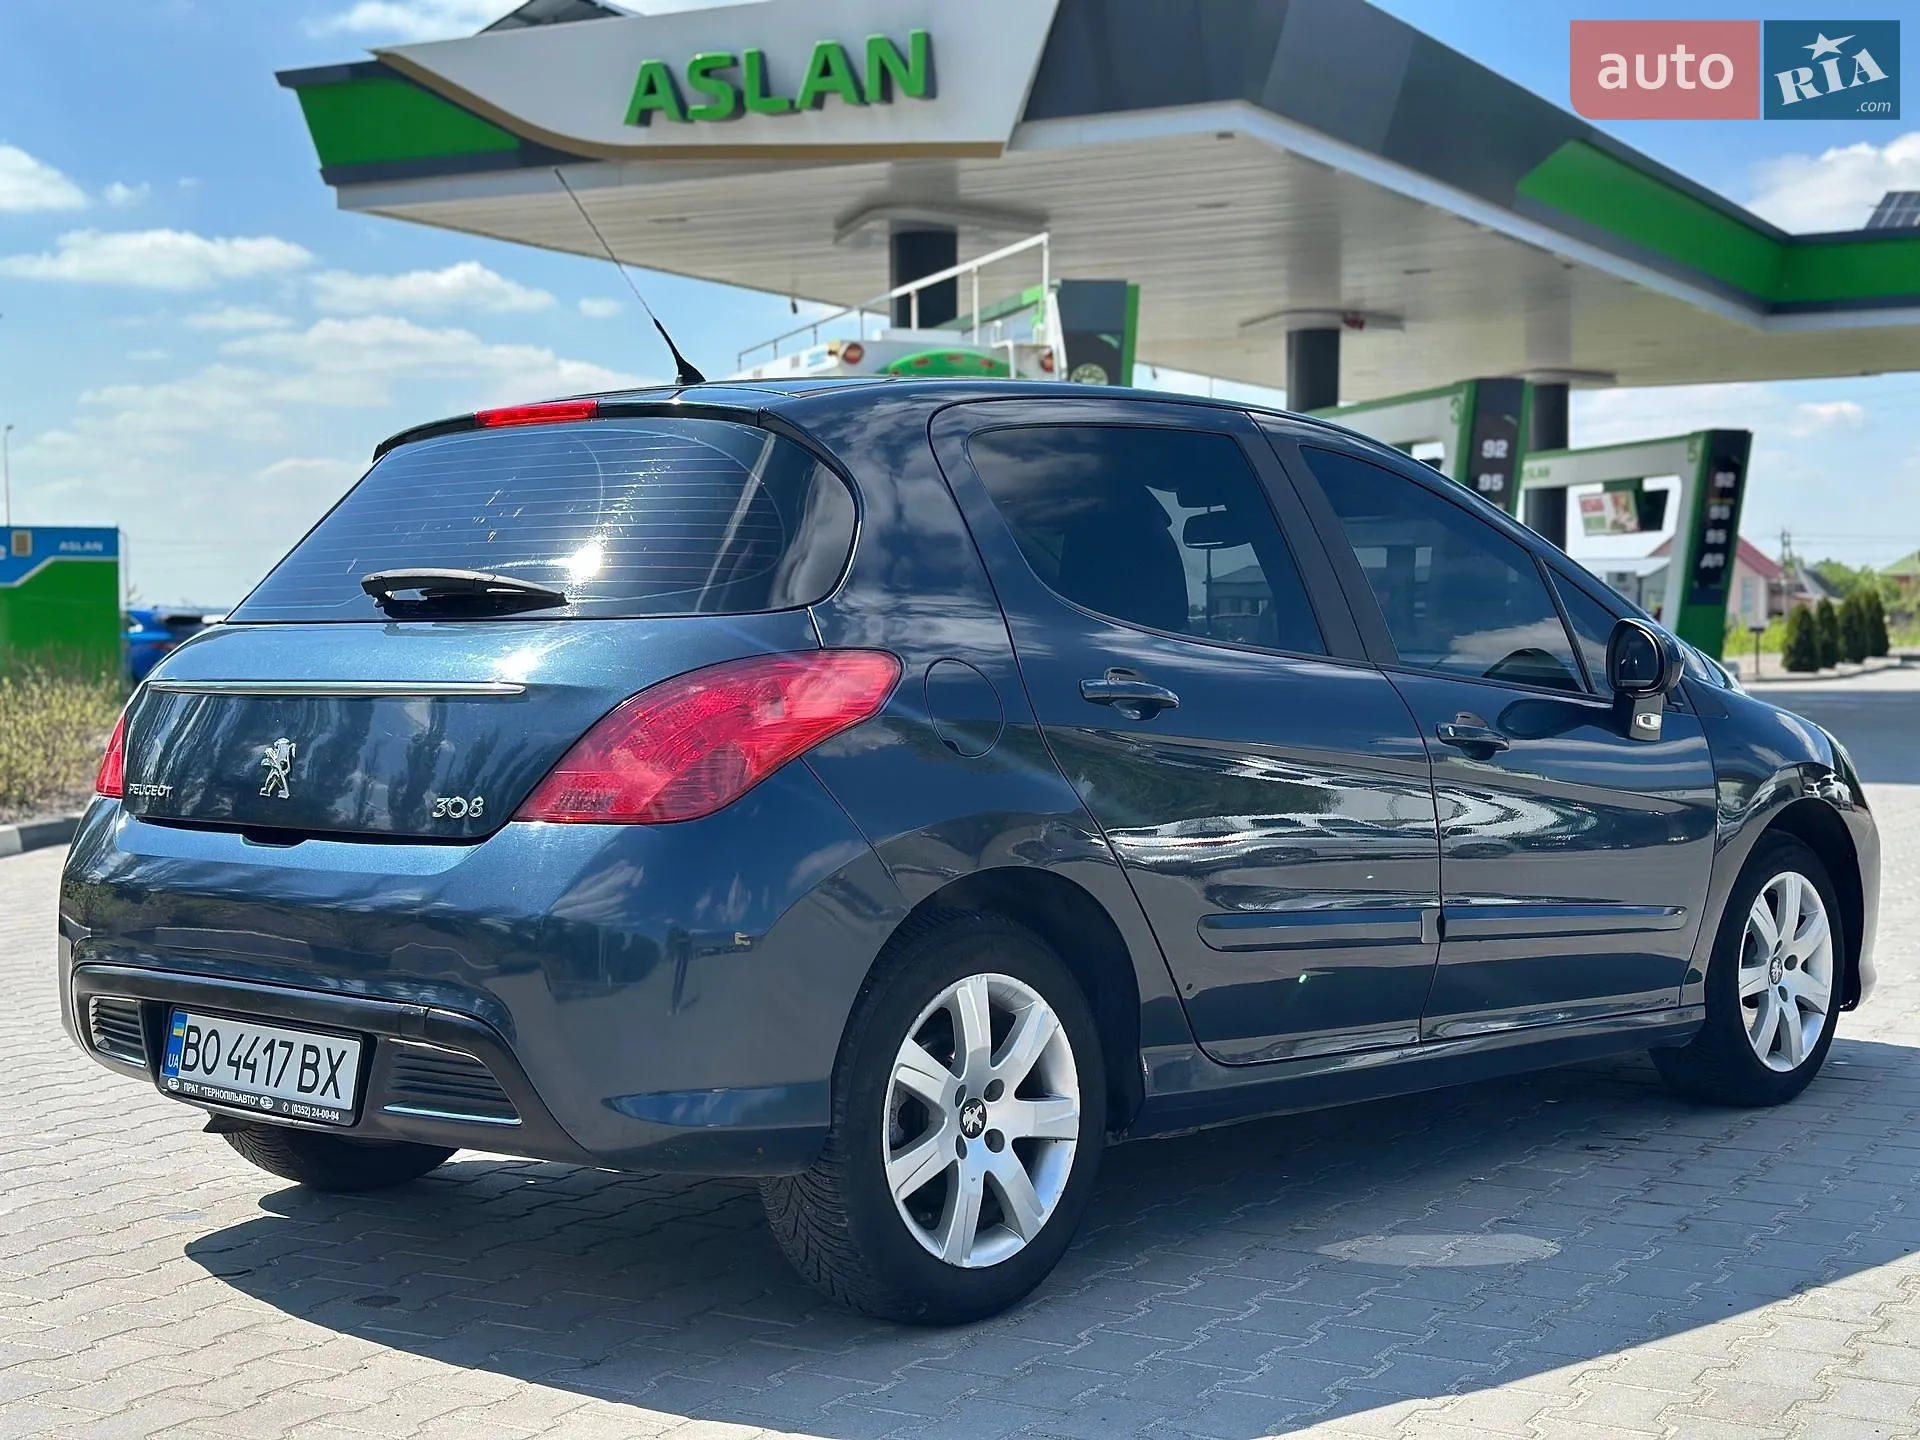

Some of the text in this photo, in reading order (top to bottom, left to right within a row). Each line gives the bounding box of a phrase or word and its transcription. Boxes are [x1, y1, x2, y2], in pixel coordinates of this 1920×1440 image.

[623, 28, 936, 126] ASLAN
[1482, 439, 1509, 459] 92
[1477, 473, 1504, 491] 95
[1714, 471, 1736, 488] 92
[58, 540, 104, 552] ASLAN
[128, 782, 174, 798] PEUGEOT
[432, 796, 484, 819] 308
[167, 1053, 180, 1069] UA
[181, 1025, 348, 1100] BO 4417 BX
[183, 1081, 199, 1095] ПРАТ
